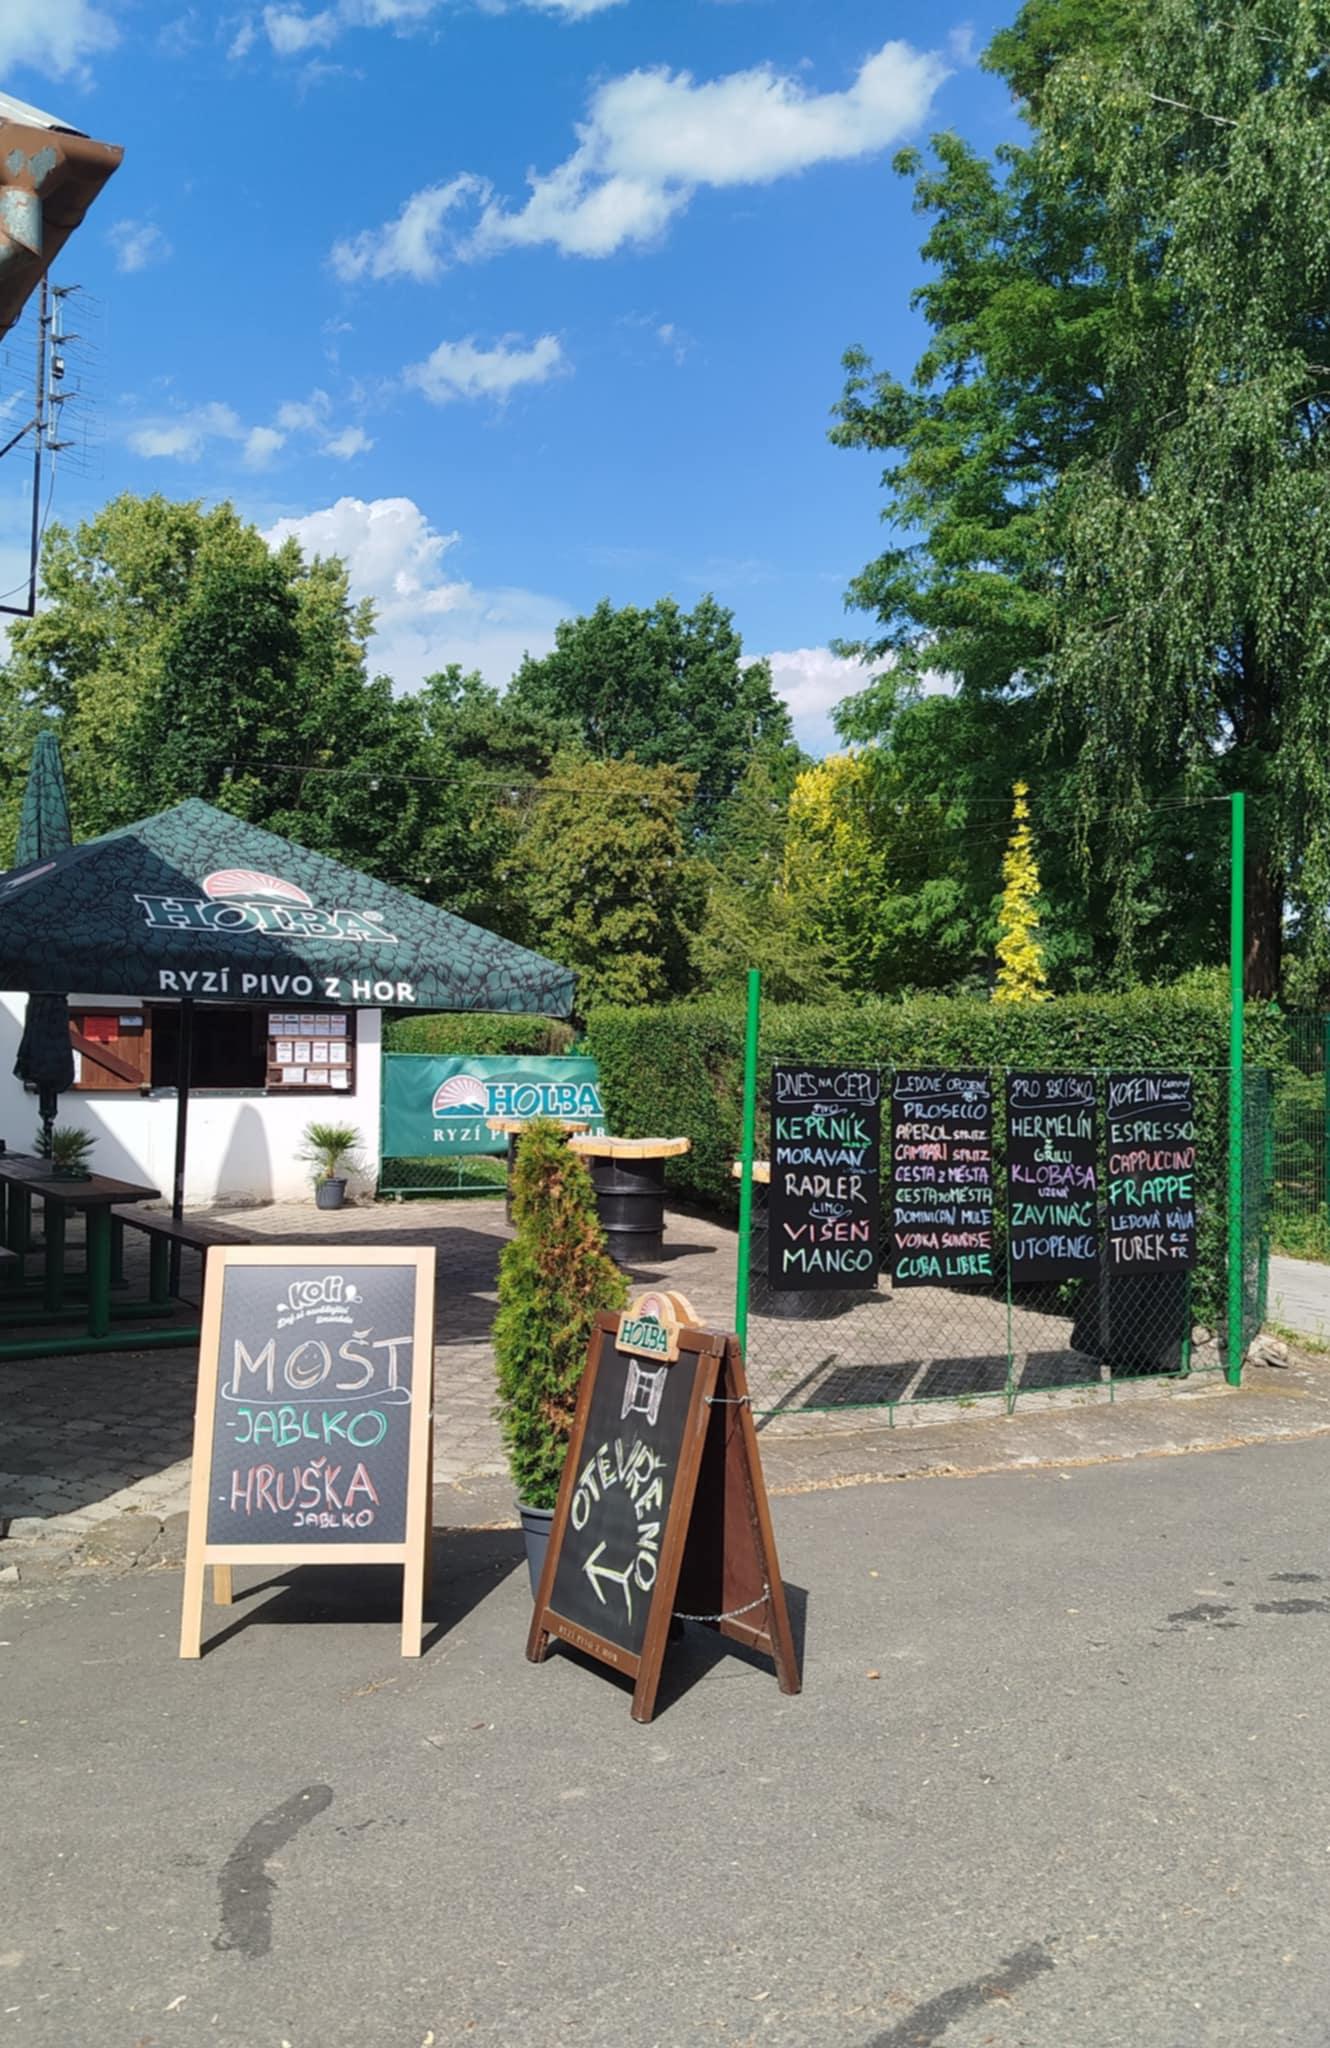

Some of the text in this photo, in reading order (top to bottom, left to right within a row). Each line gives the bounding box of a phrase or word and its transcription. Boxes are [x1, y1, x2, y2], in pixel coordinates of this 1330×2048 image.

[133, 894, 398, 943] HOLBA
[159, 967, 416, 1002] RYZÍ PIVO Z HOR
[776, 1072, 819, 1098] DNES
[818, 1078, 833, 1088] NA
[895, 1073, 946, 1093] LEDOVÉ
[1011, 1080, 1041, 1098] PRO
[1109, 1078, 1162, 1108] KOFEIN
[484, 1083, 605, 1118] HOLBA
[903, 1102, 987, 1120] PROSECCO
[433, 1125, 481, 1142] RYZÍ
[776, 1112, 872, 1144] KEPRNÍK
[895, 1122, 952, 1141] APEROL
[1011, 1109, 1092, 1140] HERMELÍN
[1110, 1121, 1195, 1144] ESPRESSO
[776, 1147, 865, 1168] MORAVAN
[895, 1142, 948, 1162] CAMPARI
[1109, 1147, 1196, 1175] CAPPUCCINO
[895, 1165, 935, 1183] CESTA
[785, 1173, 868, 1204] RADLER
[895, 1187, 937, 1205] CESTA
[1108, 1173, 1194, 1207] FRAPPE
[812, 1202, 844, 1215] LIMO
[893, 1206, 993, 1227] DOMINICAN MULE
[783, 1217, 870, 1243] VIŠEŇ
[1011, 1235, 1097, 1260] UTOPENEC
[1110, 1234, 1169, 1264] TUREK
[1170, 1246, 1190, 1259] TR
[783, 1248, 873, 1273] MANGO
[896, 1253, 993, 1279] CUBA LIBRE
[620, 1319, 668, 1352] HOLBA
[231, 1327, 413, 1395] MOŠT
[292, 1509, 374, 1529] JABLKO
